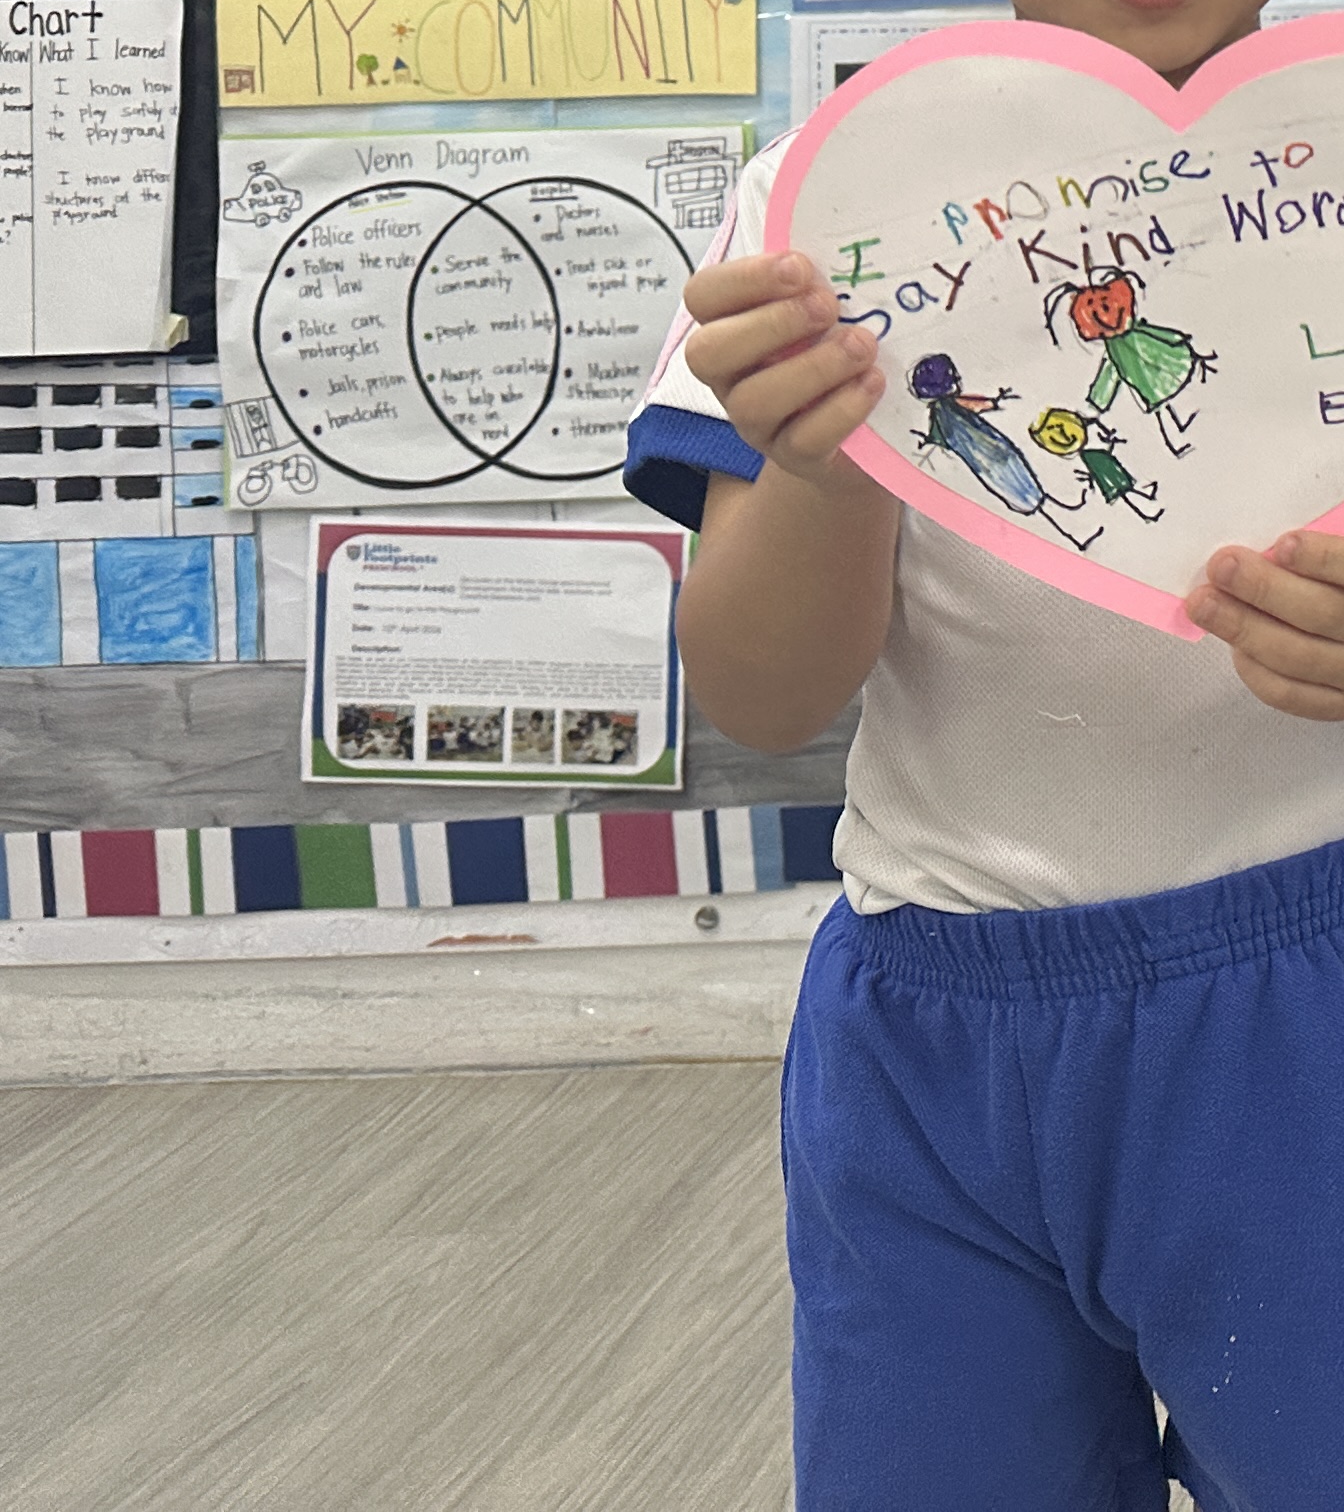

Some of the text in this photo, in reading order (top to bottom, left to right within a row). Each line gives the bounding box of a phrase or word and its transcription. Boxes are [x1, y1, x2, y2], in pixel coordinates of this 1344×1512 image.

[9, 0, 103, 36] Chart
[39, 38, 166, 64] What I learned
[54, 77, 69, 95] I
[89, 79, 131, 97] know
[355, 139, 530, 178] Venn Diagram
[57, 170, 70, 185] I
[248, 194, 289, 208] POLICE
[830, 238, 886, 288] I
[1250, 142, 1315, 188] to
[311, 219, 423, 248] Police officers
[1017, 215, 1176, 285] Kind
[303, 252, 417, 276] Follow the rules
[298, 274, 363, 299] and law
[436, 269, 513, 294] community
[298, 319, 337, 338] Police
[298, 337, 381, 362] motorcycles
[324, 400, 399, 431] handcuffs
[364, 542, 401, 553] Little
[364, 552, 438, 565] Footprints
